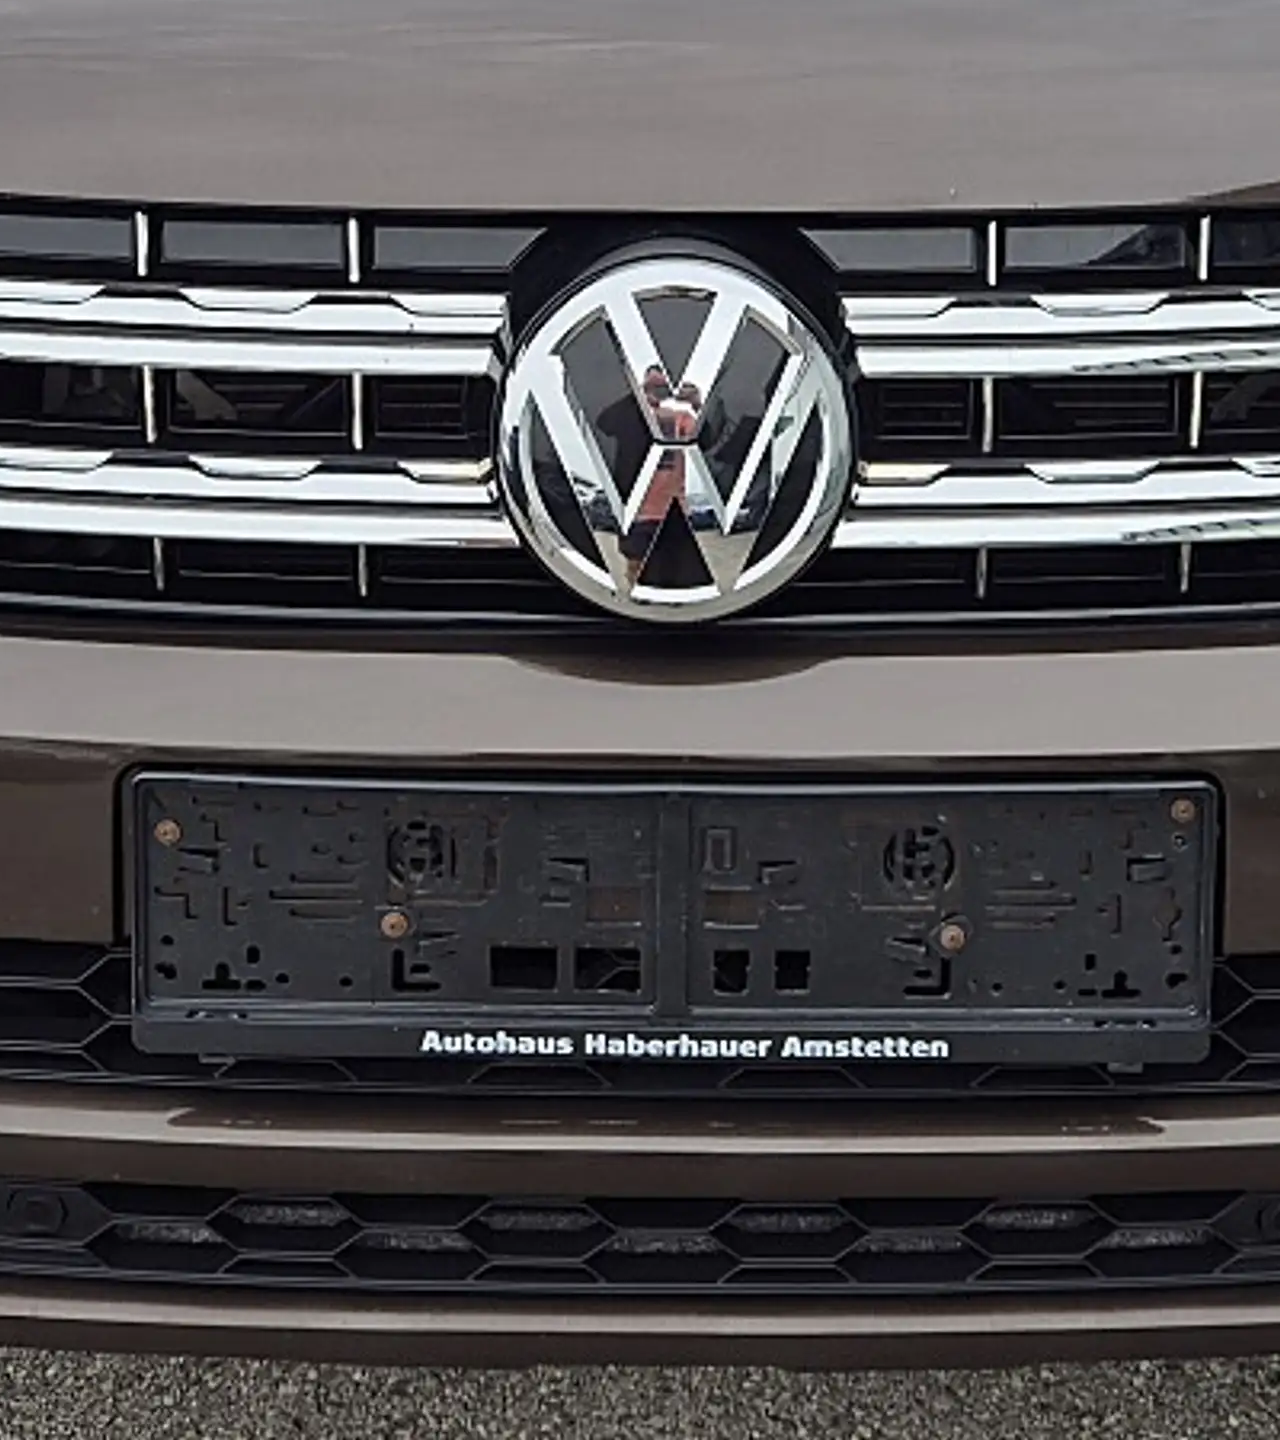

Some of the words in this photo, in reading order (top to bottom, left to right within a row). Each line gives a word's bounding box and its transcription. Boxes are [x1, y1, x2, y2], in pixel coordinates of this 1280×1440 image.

[420, 1030, 574, 1055] Autohaus
[584, 1033, 773, 1058] Haberhauer
[780, 1035, 950, 1058] Amstetten
